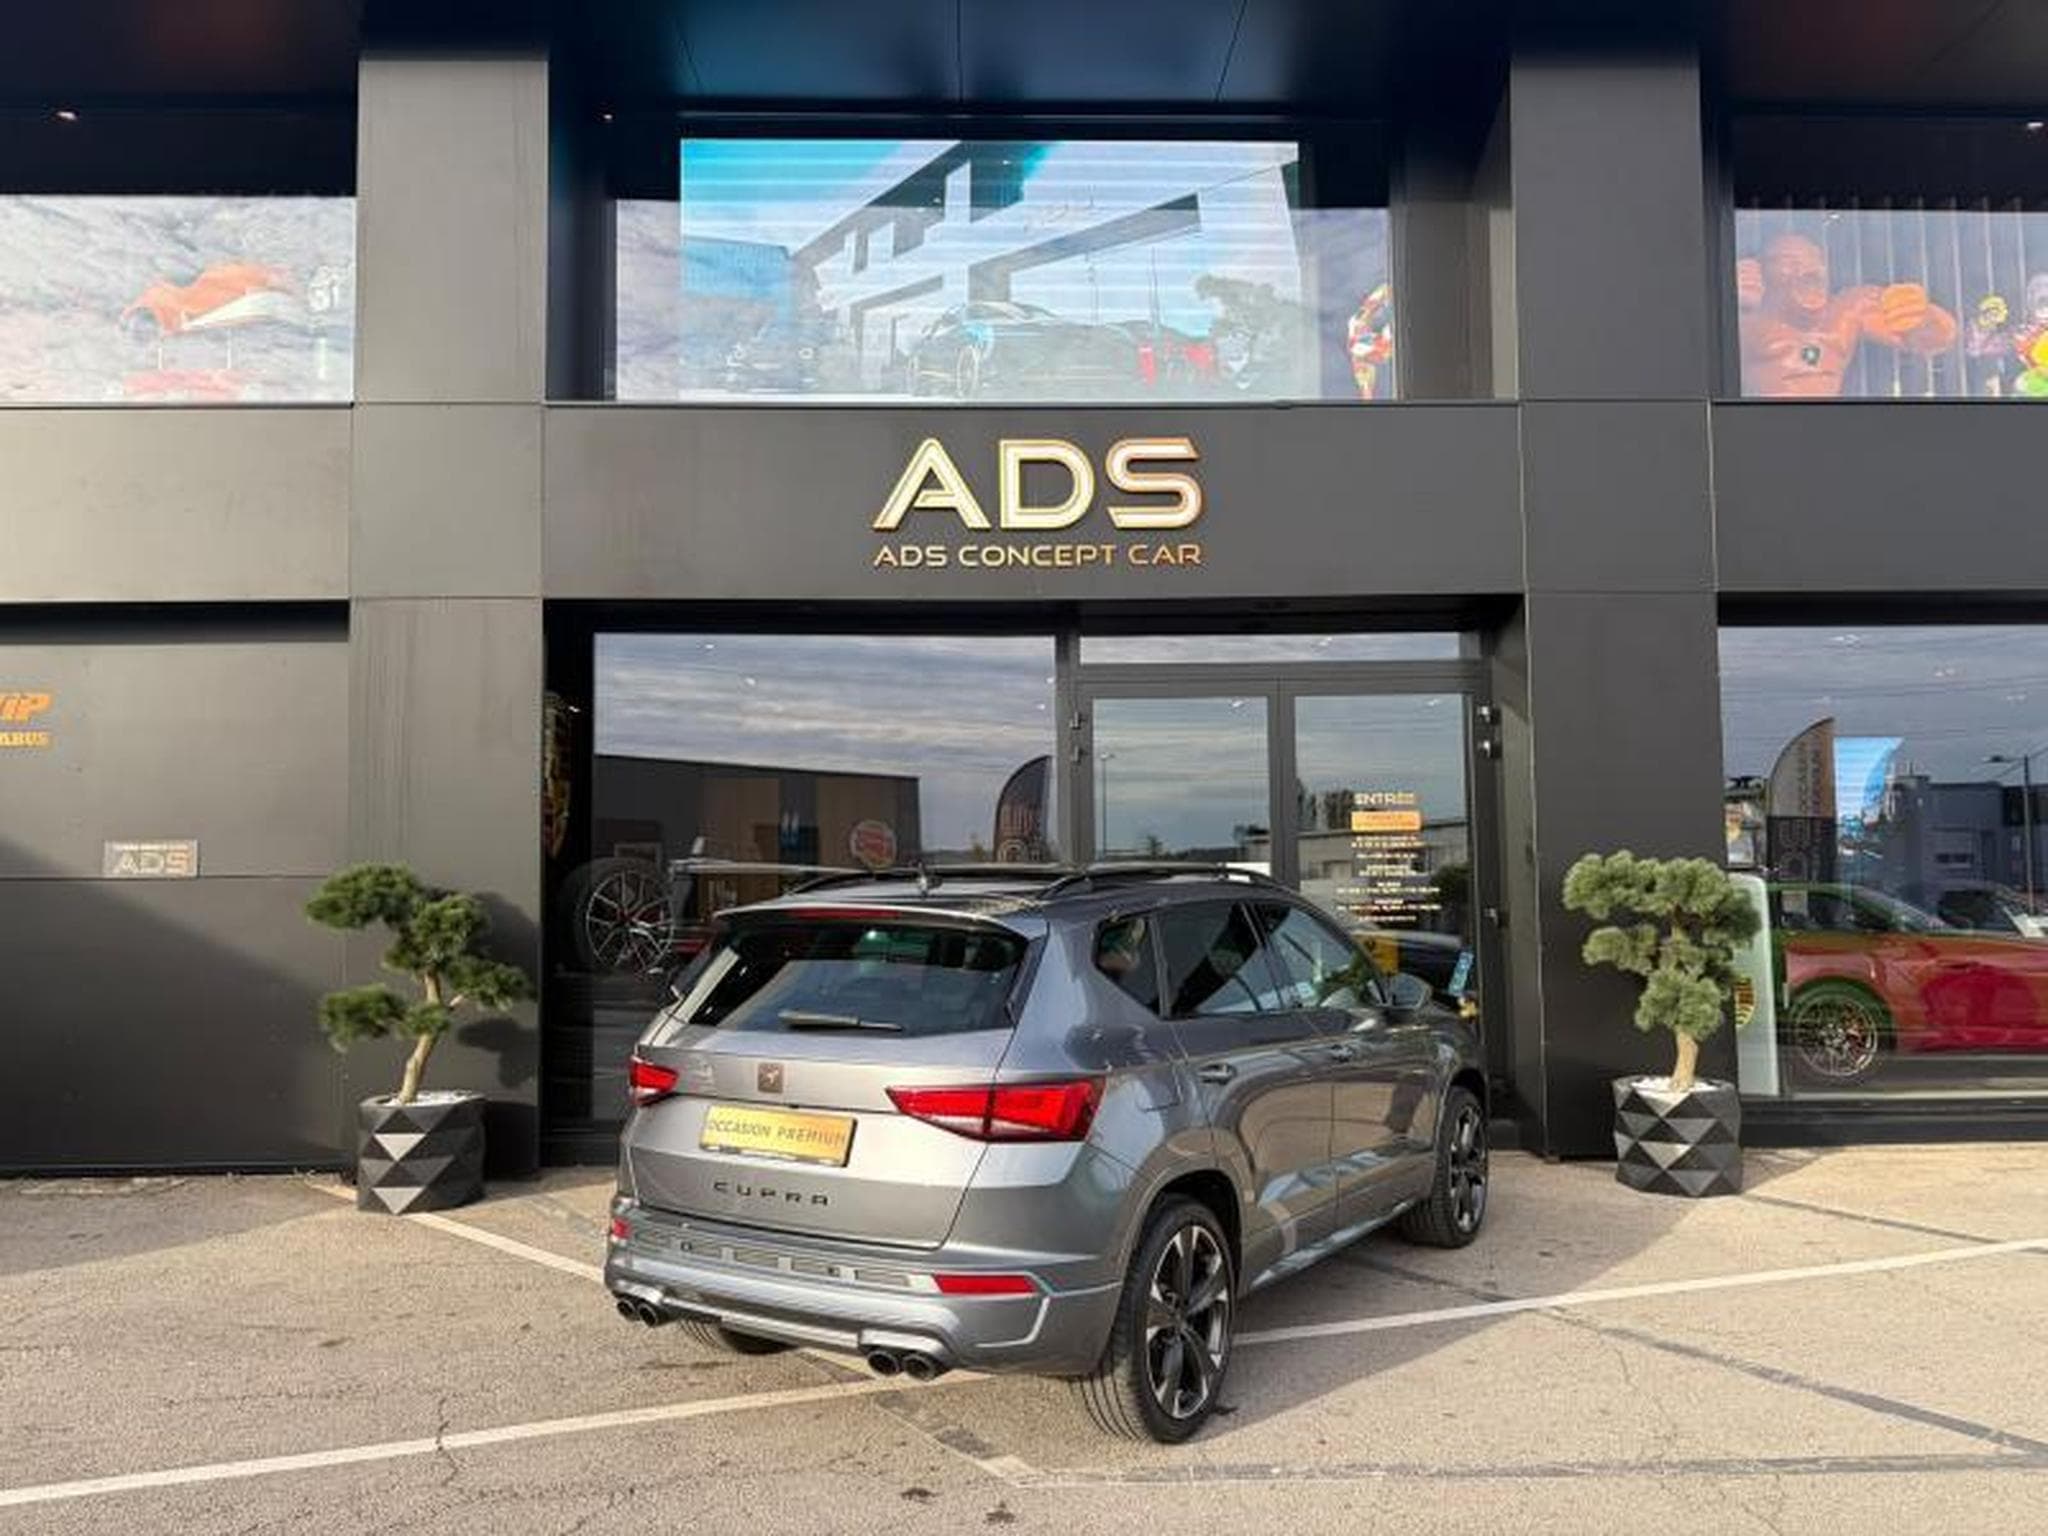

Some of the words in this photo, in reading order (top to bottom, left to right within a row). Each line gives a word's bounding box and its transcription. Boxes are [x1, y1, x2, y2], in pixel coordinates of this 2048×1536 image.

[872, 437, 1202, 531] ADS
[873, 545, 947, 568] ADS
[958, 544, 1117, 568] CONCEPT
[1127, 544, 1202, 566] CAR
[112, 851, 189, 875] ADS
[709, 1117, 772, 1138] OCCASION
[776, 1126, 847, 1148] PREMIUM
[713, 1180, 829, 1207] CUPRA
